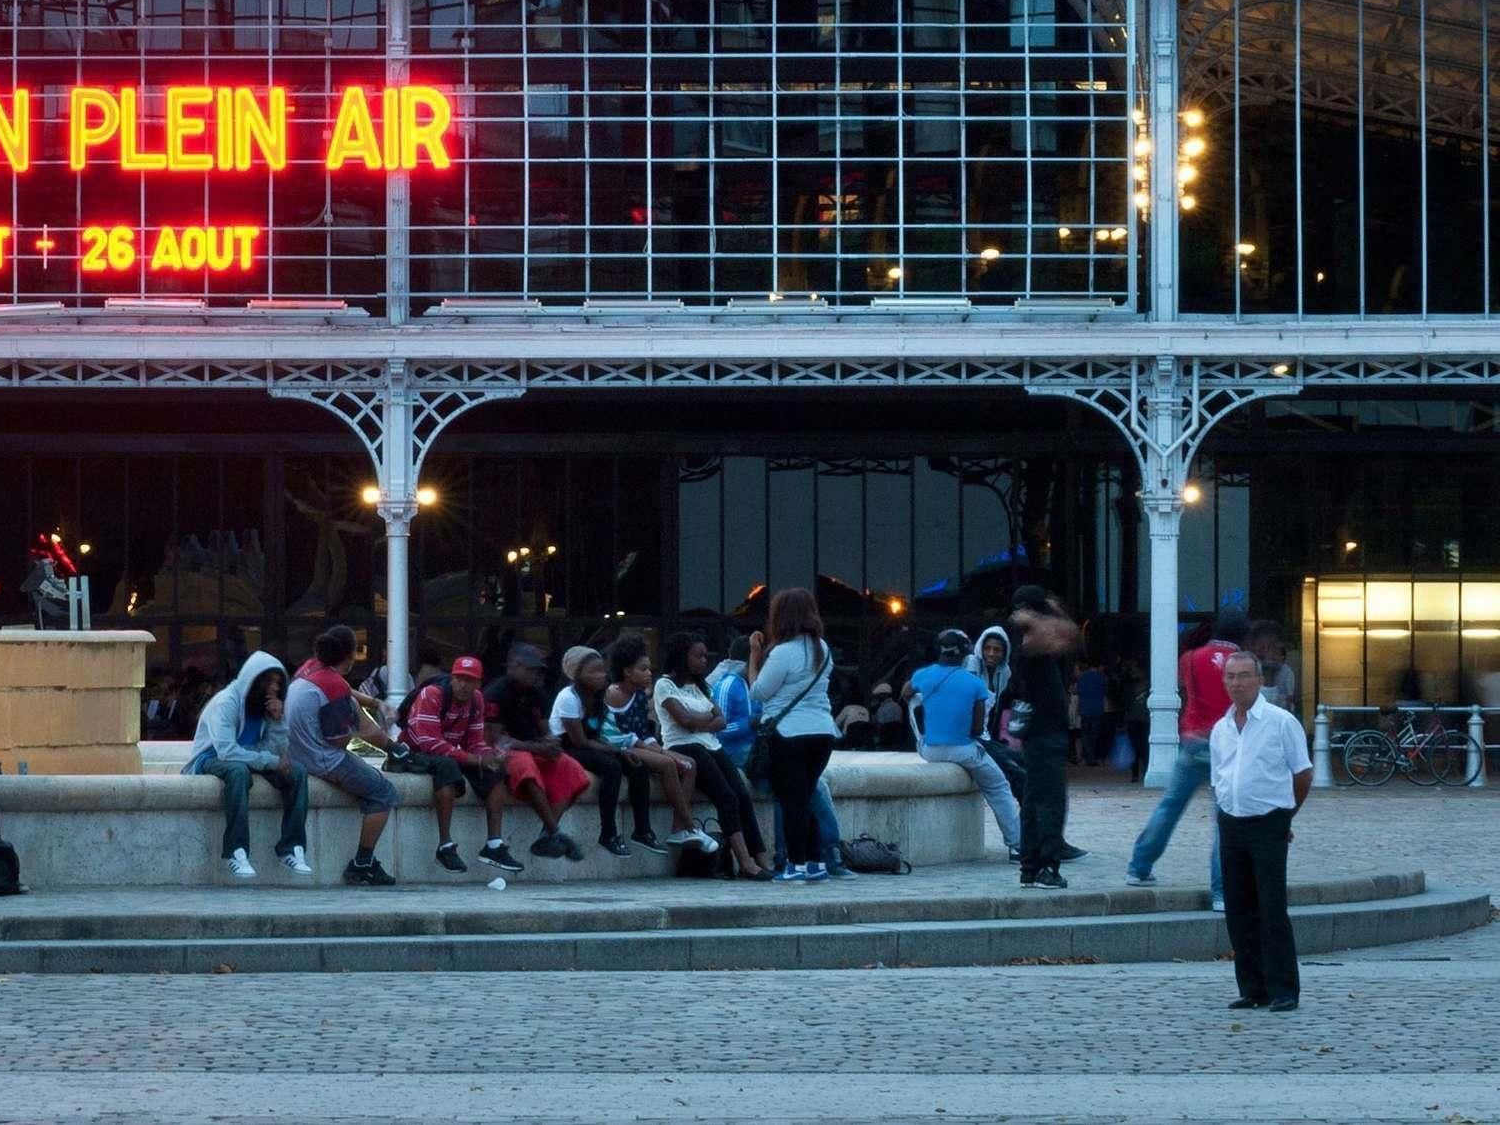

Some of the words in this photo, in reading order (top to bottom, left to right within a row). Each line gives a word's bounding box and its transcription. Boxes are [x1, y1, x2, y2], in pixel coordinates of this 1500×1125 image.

[70, 86, 288, 172] PLEIN
[326, 84, 455, 172] AIR
[81, 225, 136, 272] 26
[152, 225, 261, 272] AOUT
